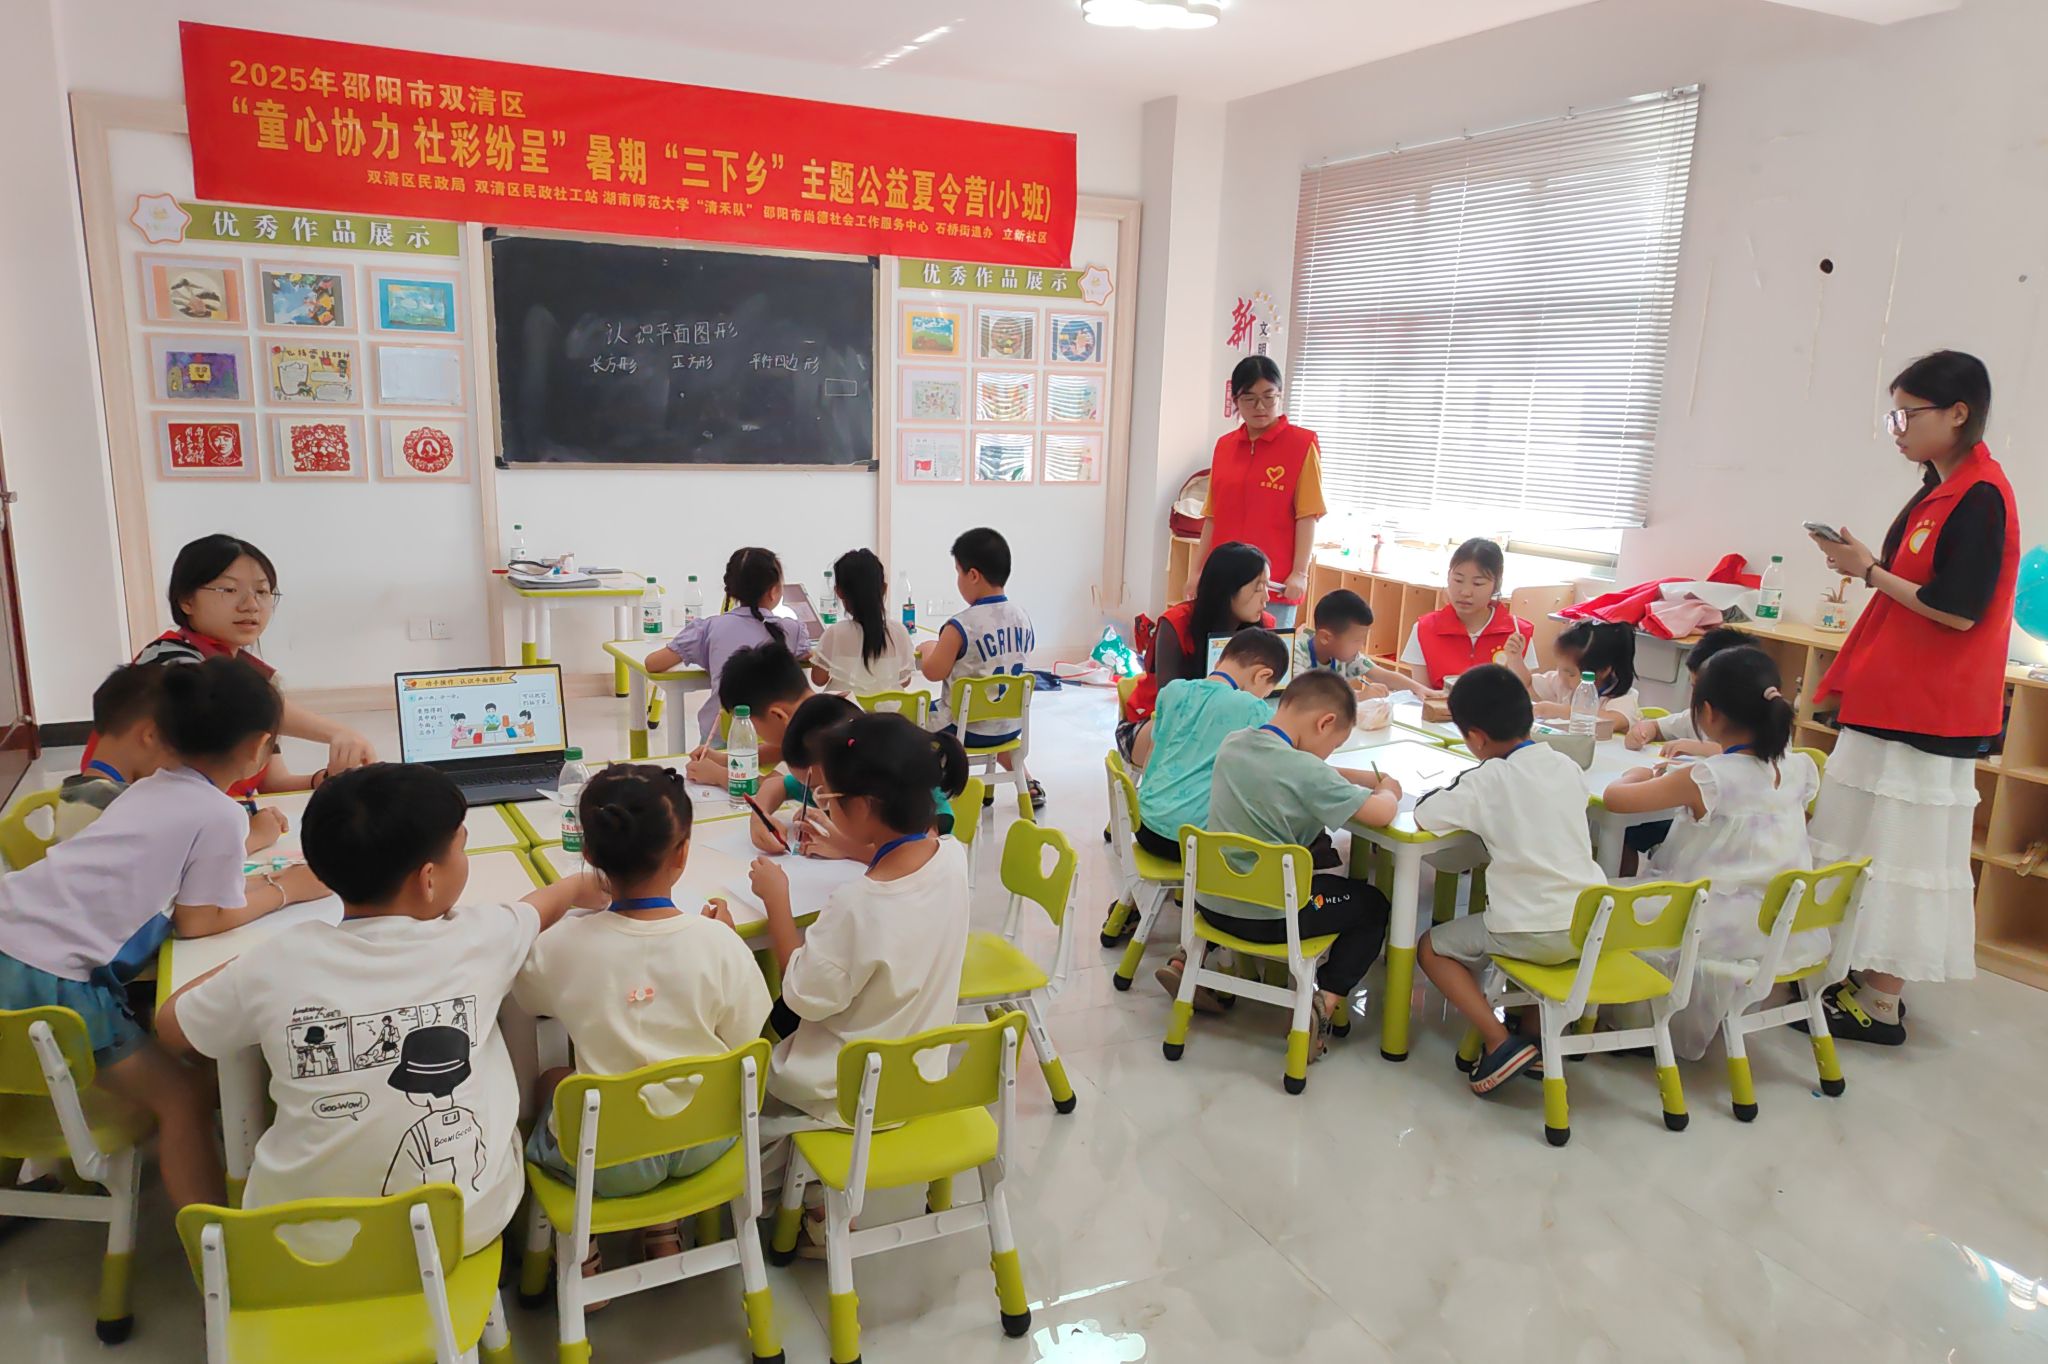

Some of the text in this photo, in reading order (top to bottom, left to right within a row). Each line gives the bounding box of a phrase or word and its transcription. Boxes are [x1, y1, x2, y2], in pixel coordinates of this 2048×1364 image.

[229, 60, 526, 119] 2025年邵阳市双清区
[586, 133, 647, 185] 暑期
[664, 142, 784, 196] “三下乡”
[366, 168, 466, 193] 双清区民政局
[763, 204, 929, 234] 邵阳市尚德社会工作服务中心
[934, 220, 994, 240] 石桥街道办
[1001, 226, 1048, 245] 立新社区
[212, 210, 431, 248] 优秀作品展示
[922, 262, 1068, 292] 优秀作品展示
[606, 321, 739, 346] 认识平面图形
[589, 353, 821, 375] 长方形 正方形 平行四边形
